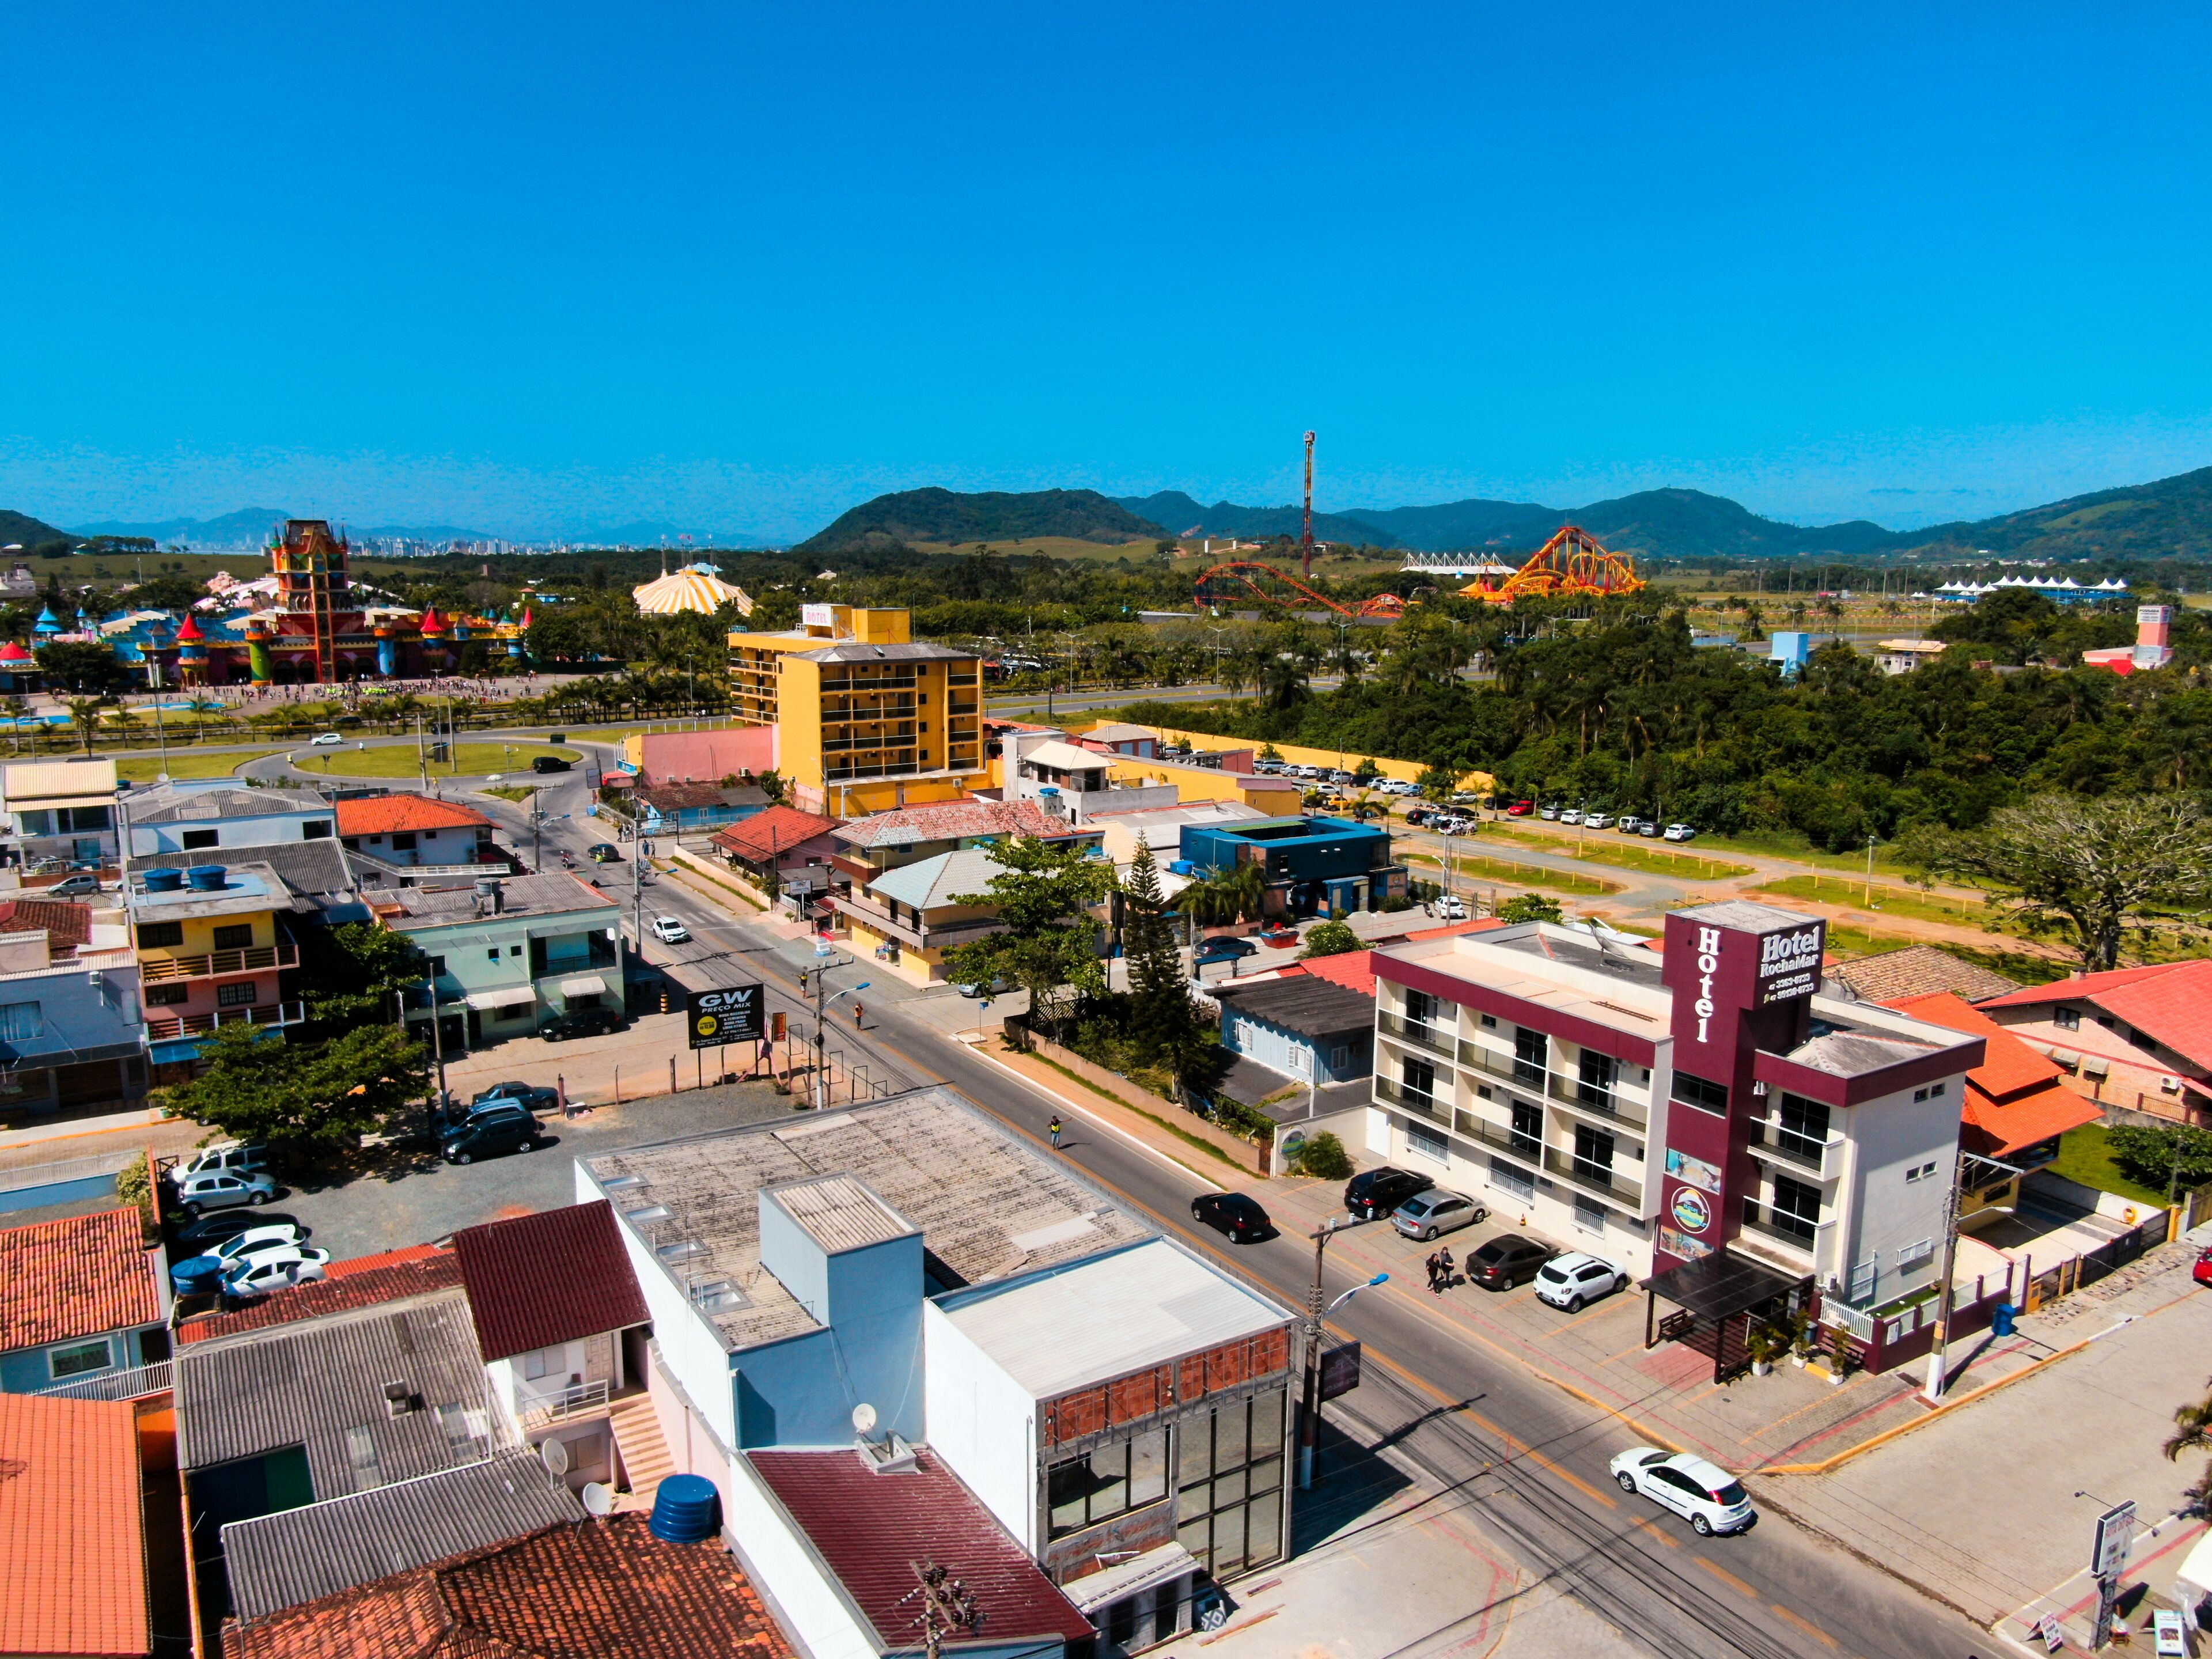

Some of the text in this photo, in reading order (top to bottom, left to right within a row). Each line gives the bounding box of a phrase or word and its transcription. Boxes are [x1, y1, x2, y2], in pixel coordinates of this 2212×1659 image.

[1762, 926, 1819, 963] Hotel
[1760, 954, 1819, 978] RochaMar
[1694, 927, 1722, 1043] Hotel
[699, 990, 753, 1007] GW
[702, 1005, 731, 1014] PREÇO
